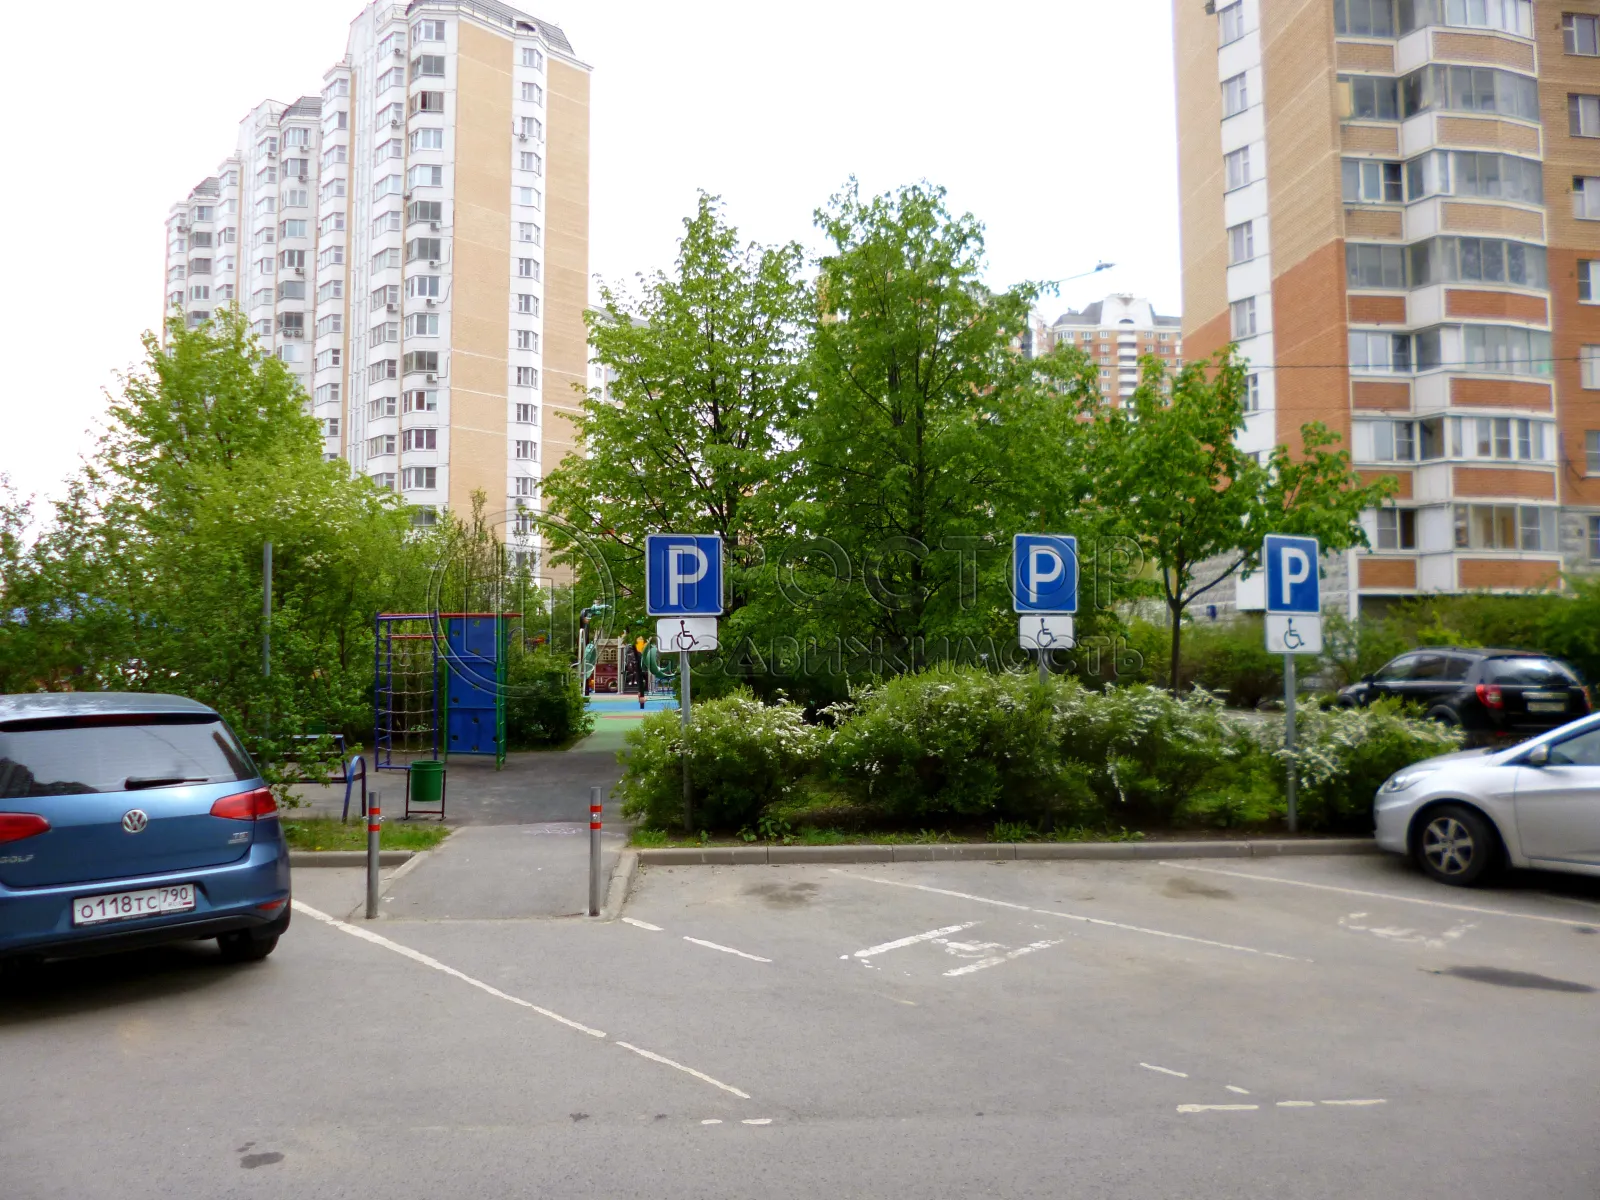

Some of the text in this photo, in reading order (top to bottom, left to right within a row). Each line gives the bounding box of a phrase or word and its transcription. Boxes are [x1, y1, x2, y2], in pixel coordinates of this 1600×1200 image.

[669, 544, 709, 606] P
[1029, 545, 1063, 603] P
[1281, 547, 1310, 605] P
[160, 887, 189, 903] 790
